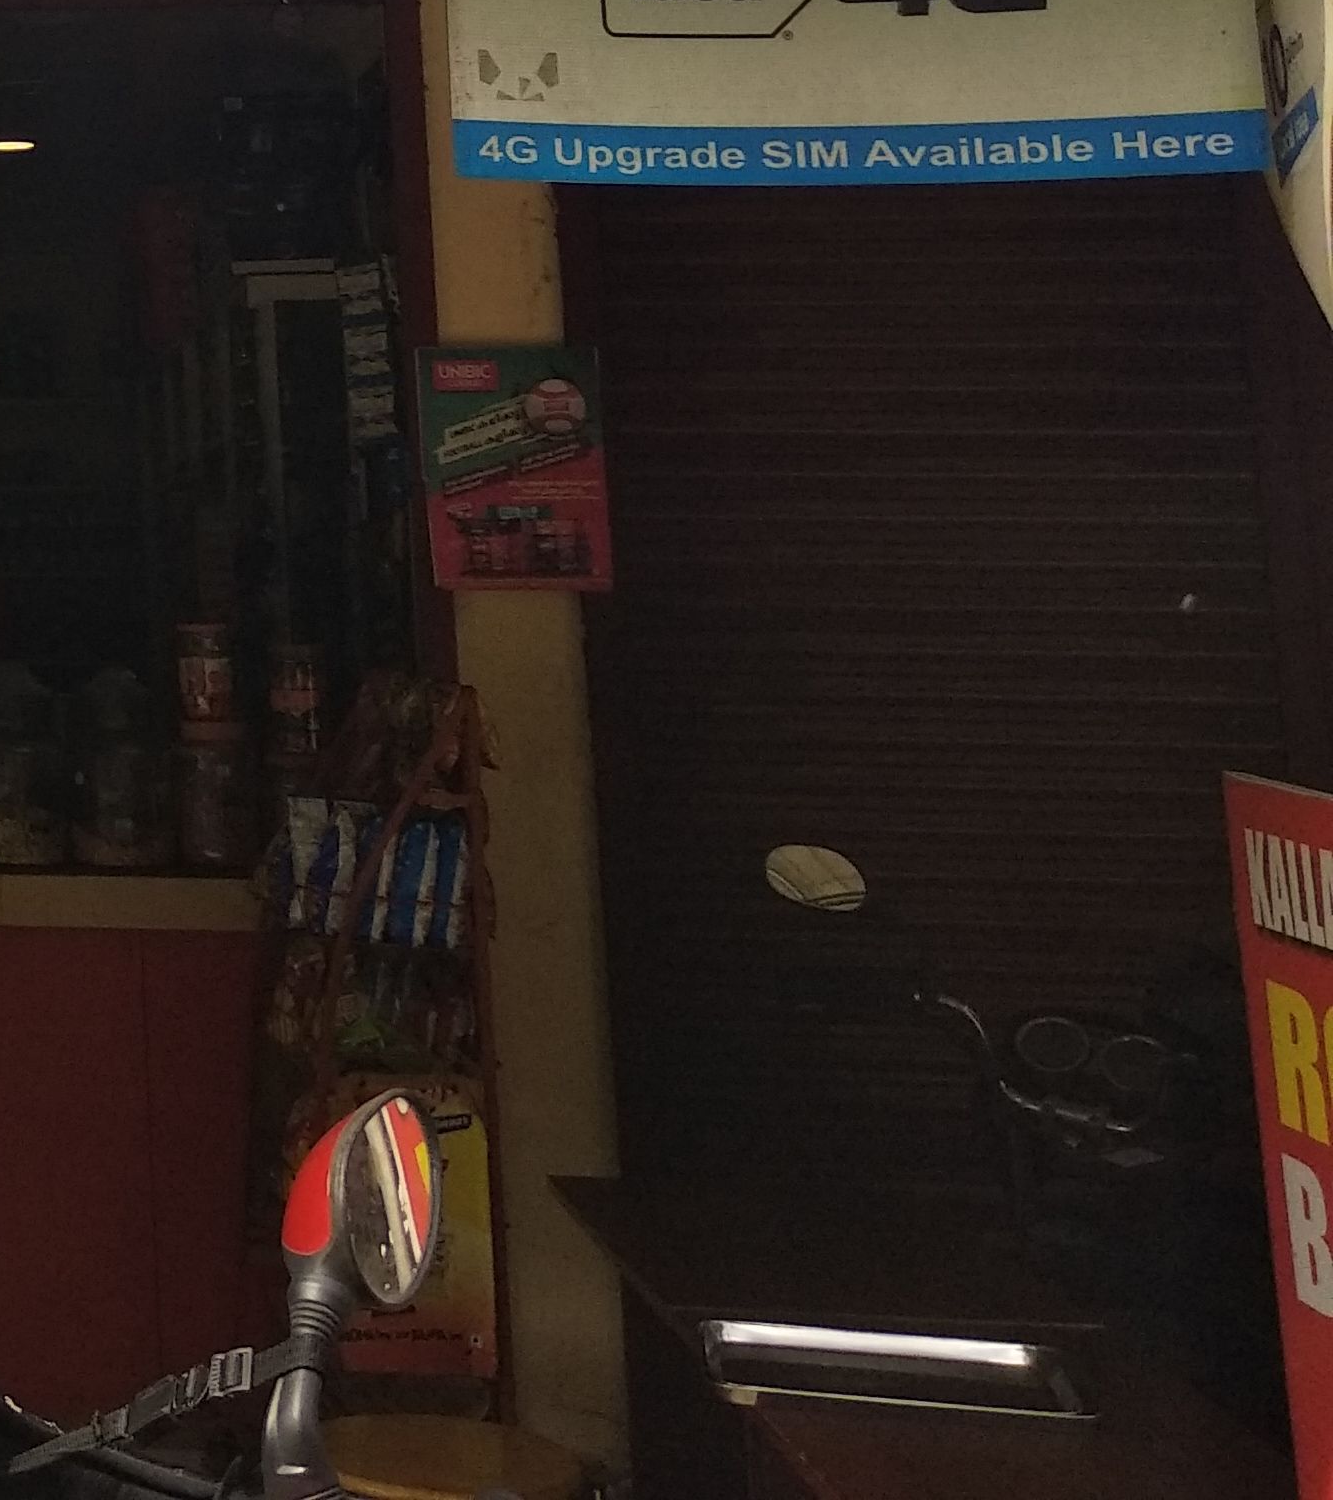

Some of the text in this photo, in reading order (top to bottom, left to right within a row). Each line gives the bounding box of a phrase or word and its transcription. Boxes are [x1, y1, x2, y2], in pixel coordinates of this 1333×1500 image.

[479, 129, 1235, 174] 4G Upgrade SIM Available Here
[1266, 979, 1333, 1147] R
